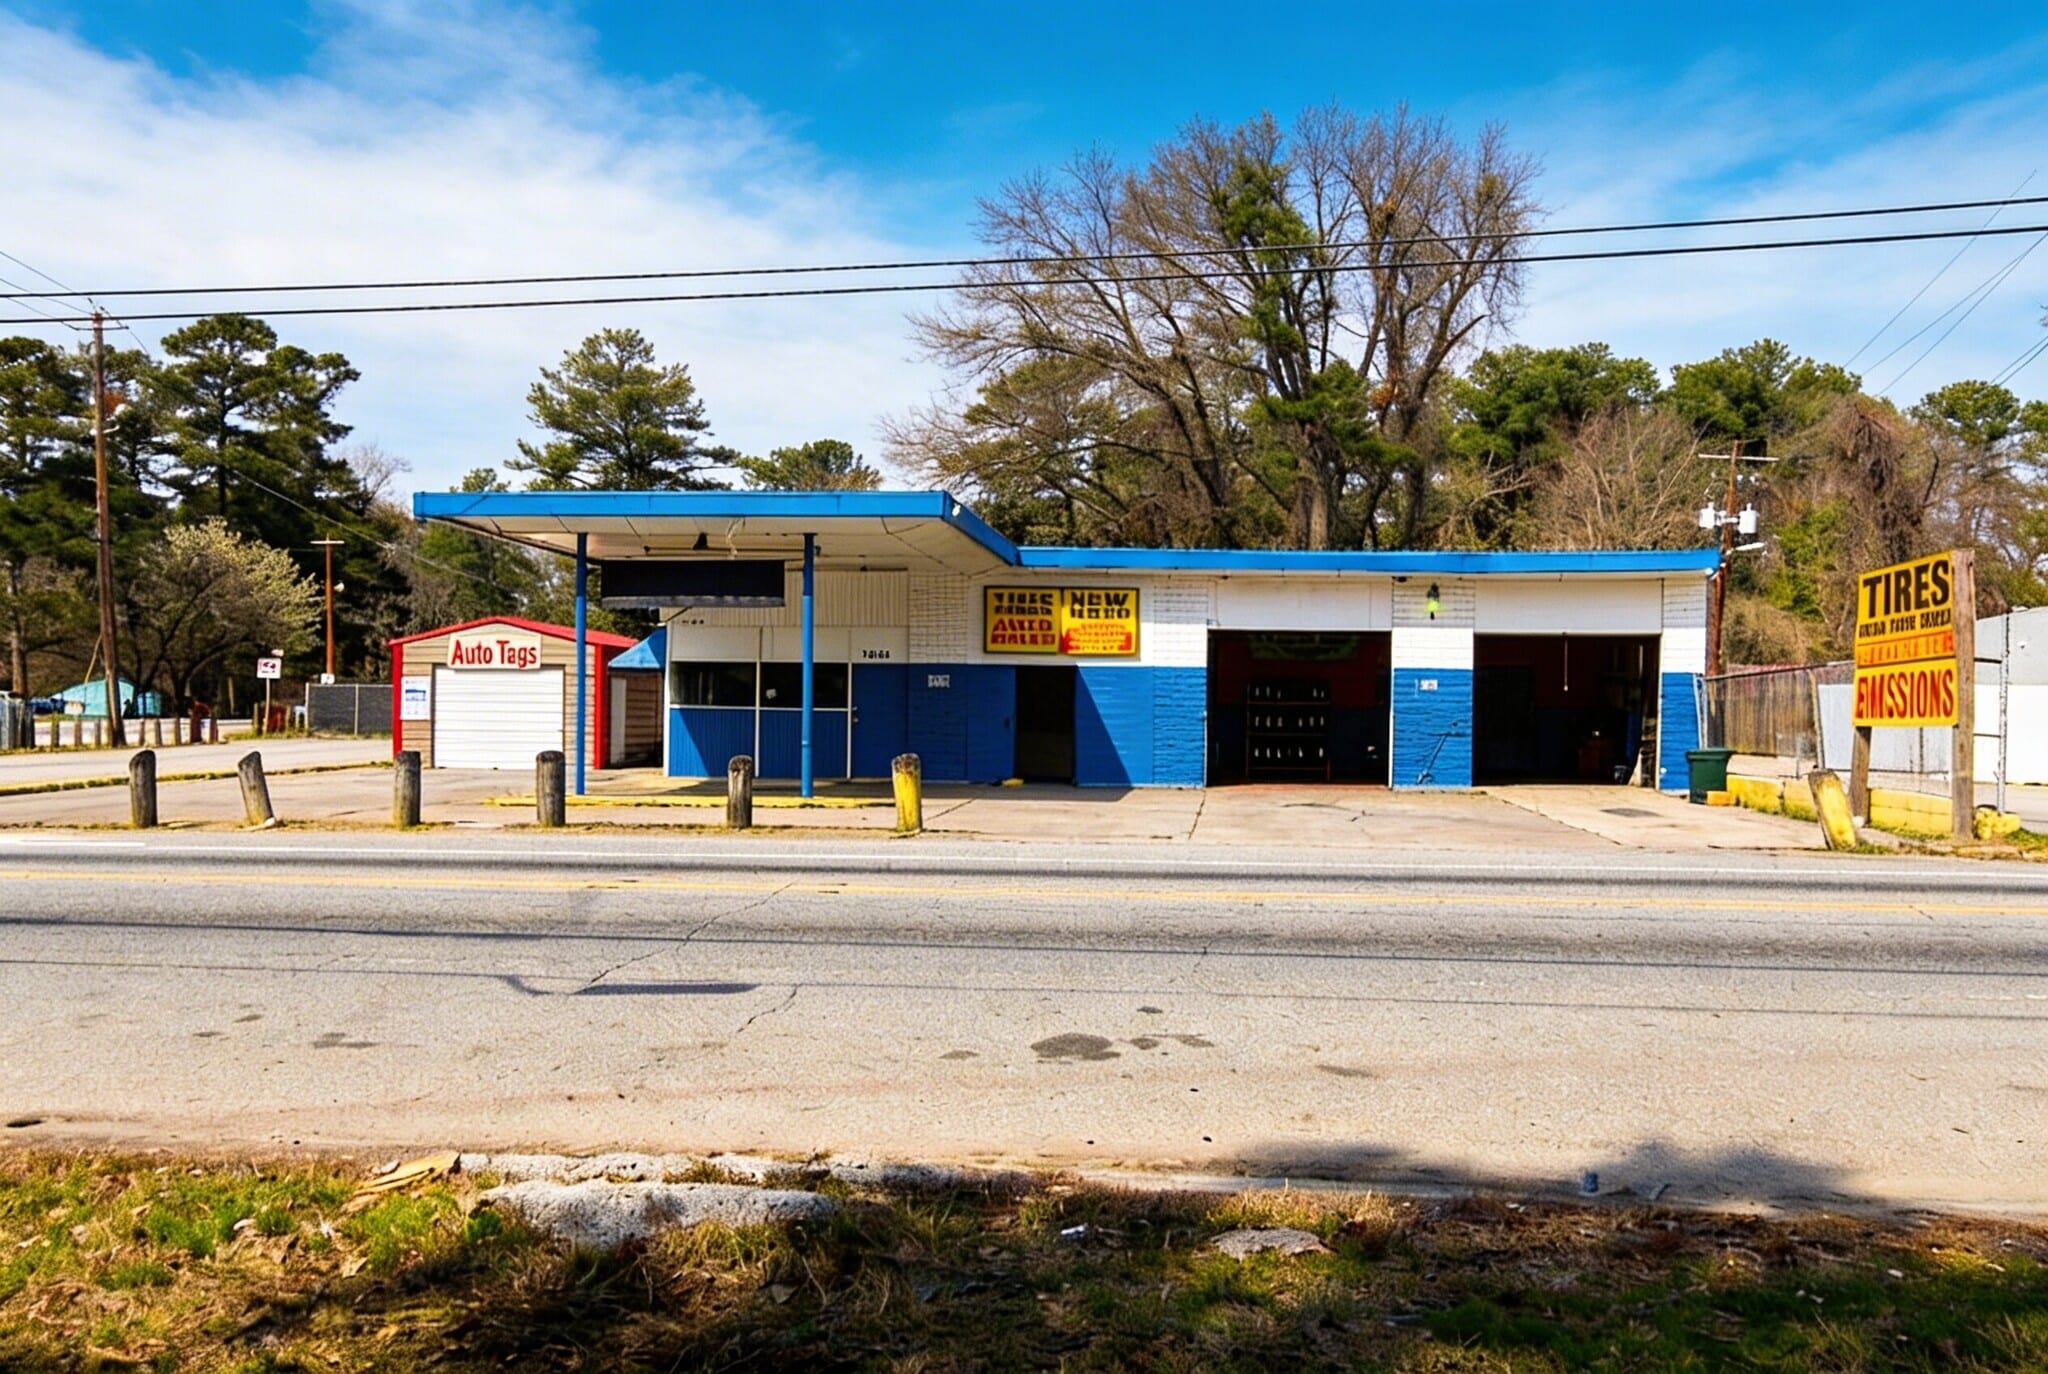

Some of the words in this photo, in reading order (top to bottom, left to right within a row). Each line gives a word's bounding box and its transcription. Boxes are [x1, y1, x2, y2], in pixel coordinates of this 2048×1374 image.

[1070, 591, 1129, 607] NEW
[1863, 560, 1949, 618] TIRES
[451, 639, 493, 666] Auto
[496, 640, 537, 668] Tags
